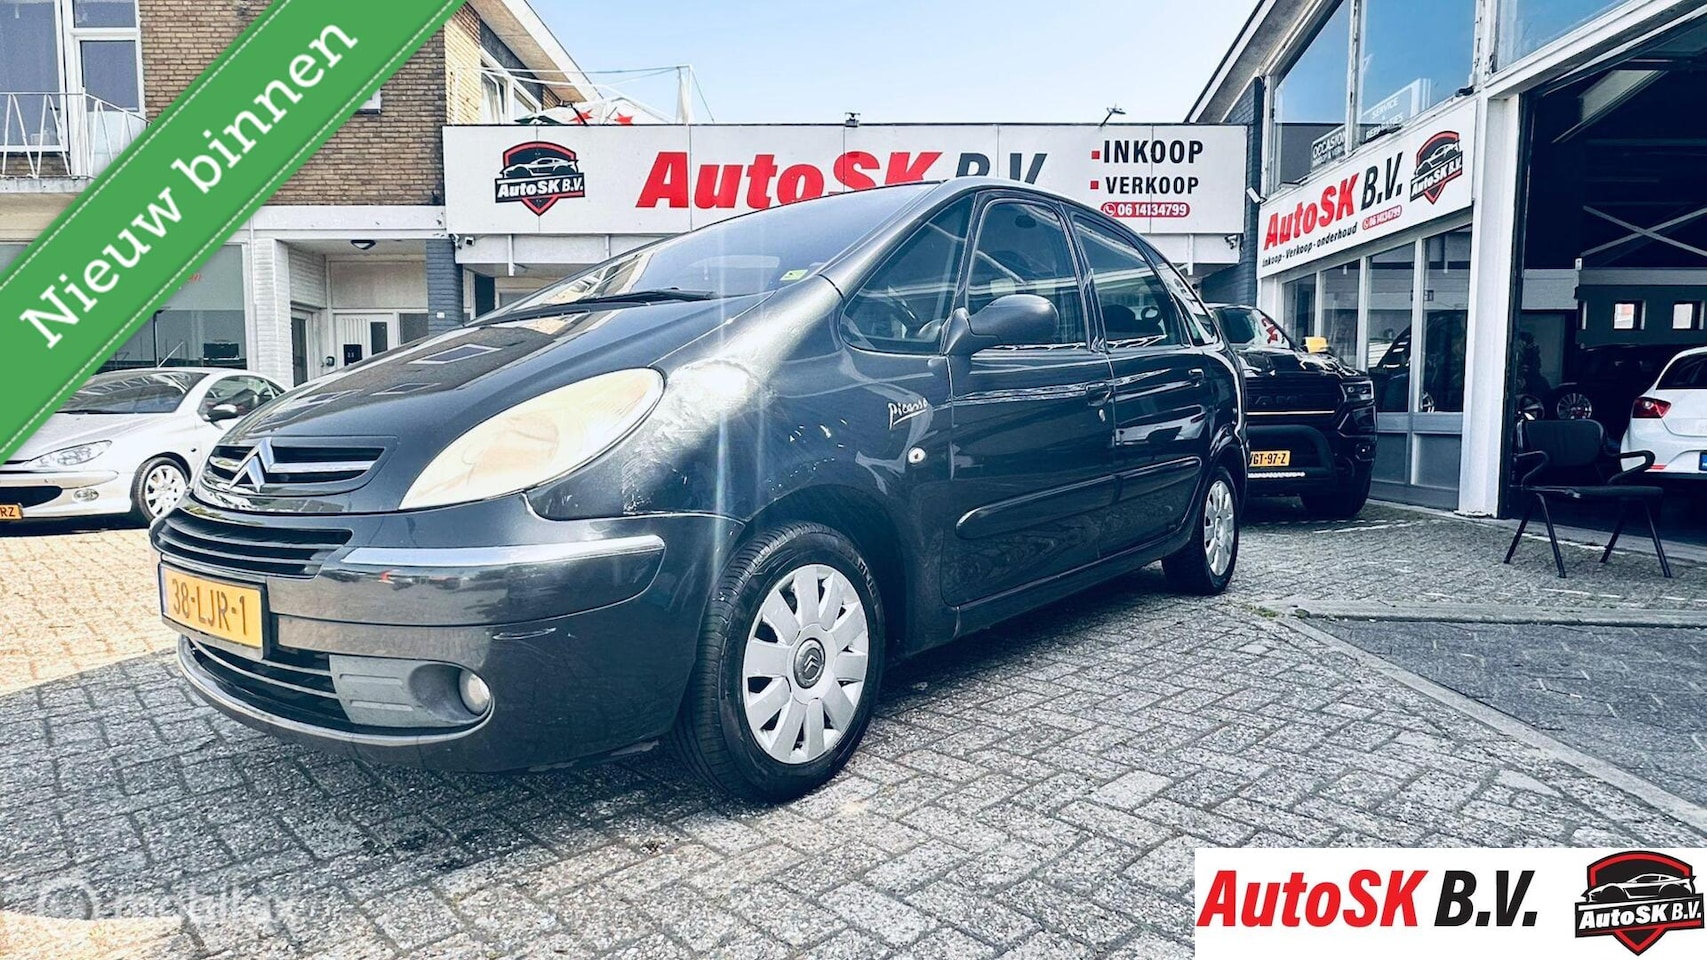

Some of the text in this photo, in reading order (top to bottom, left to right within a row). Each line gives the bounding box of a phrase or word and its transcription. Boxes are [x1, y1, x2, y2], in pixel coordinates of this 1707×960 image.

[1104, 140, 1203, 163] INKOOP
[497, 178, 583, 198] AutoSK B.V.
[635, 151, 942, 208] AutoSK
[1105, 176, 1199, 194] VERKOOP
[1411, 162, 1448, 197] AutoSK
[1117, 204, 1187, 216] 06 14134799
[1264, 152, 1403, 250] AutoSK B.V.
[1317, 222, 1358, 248] onderhoud
[172, 578, 248, 636] 38-LJR-1
